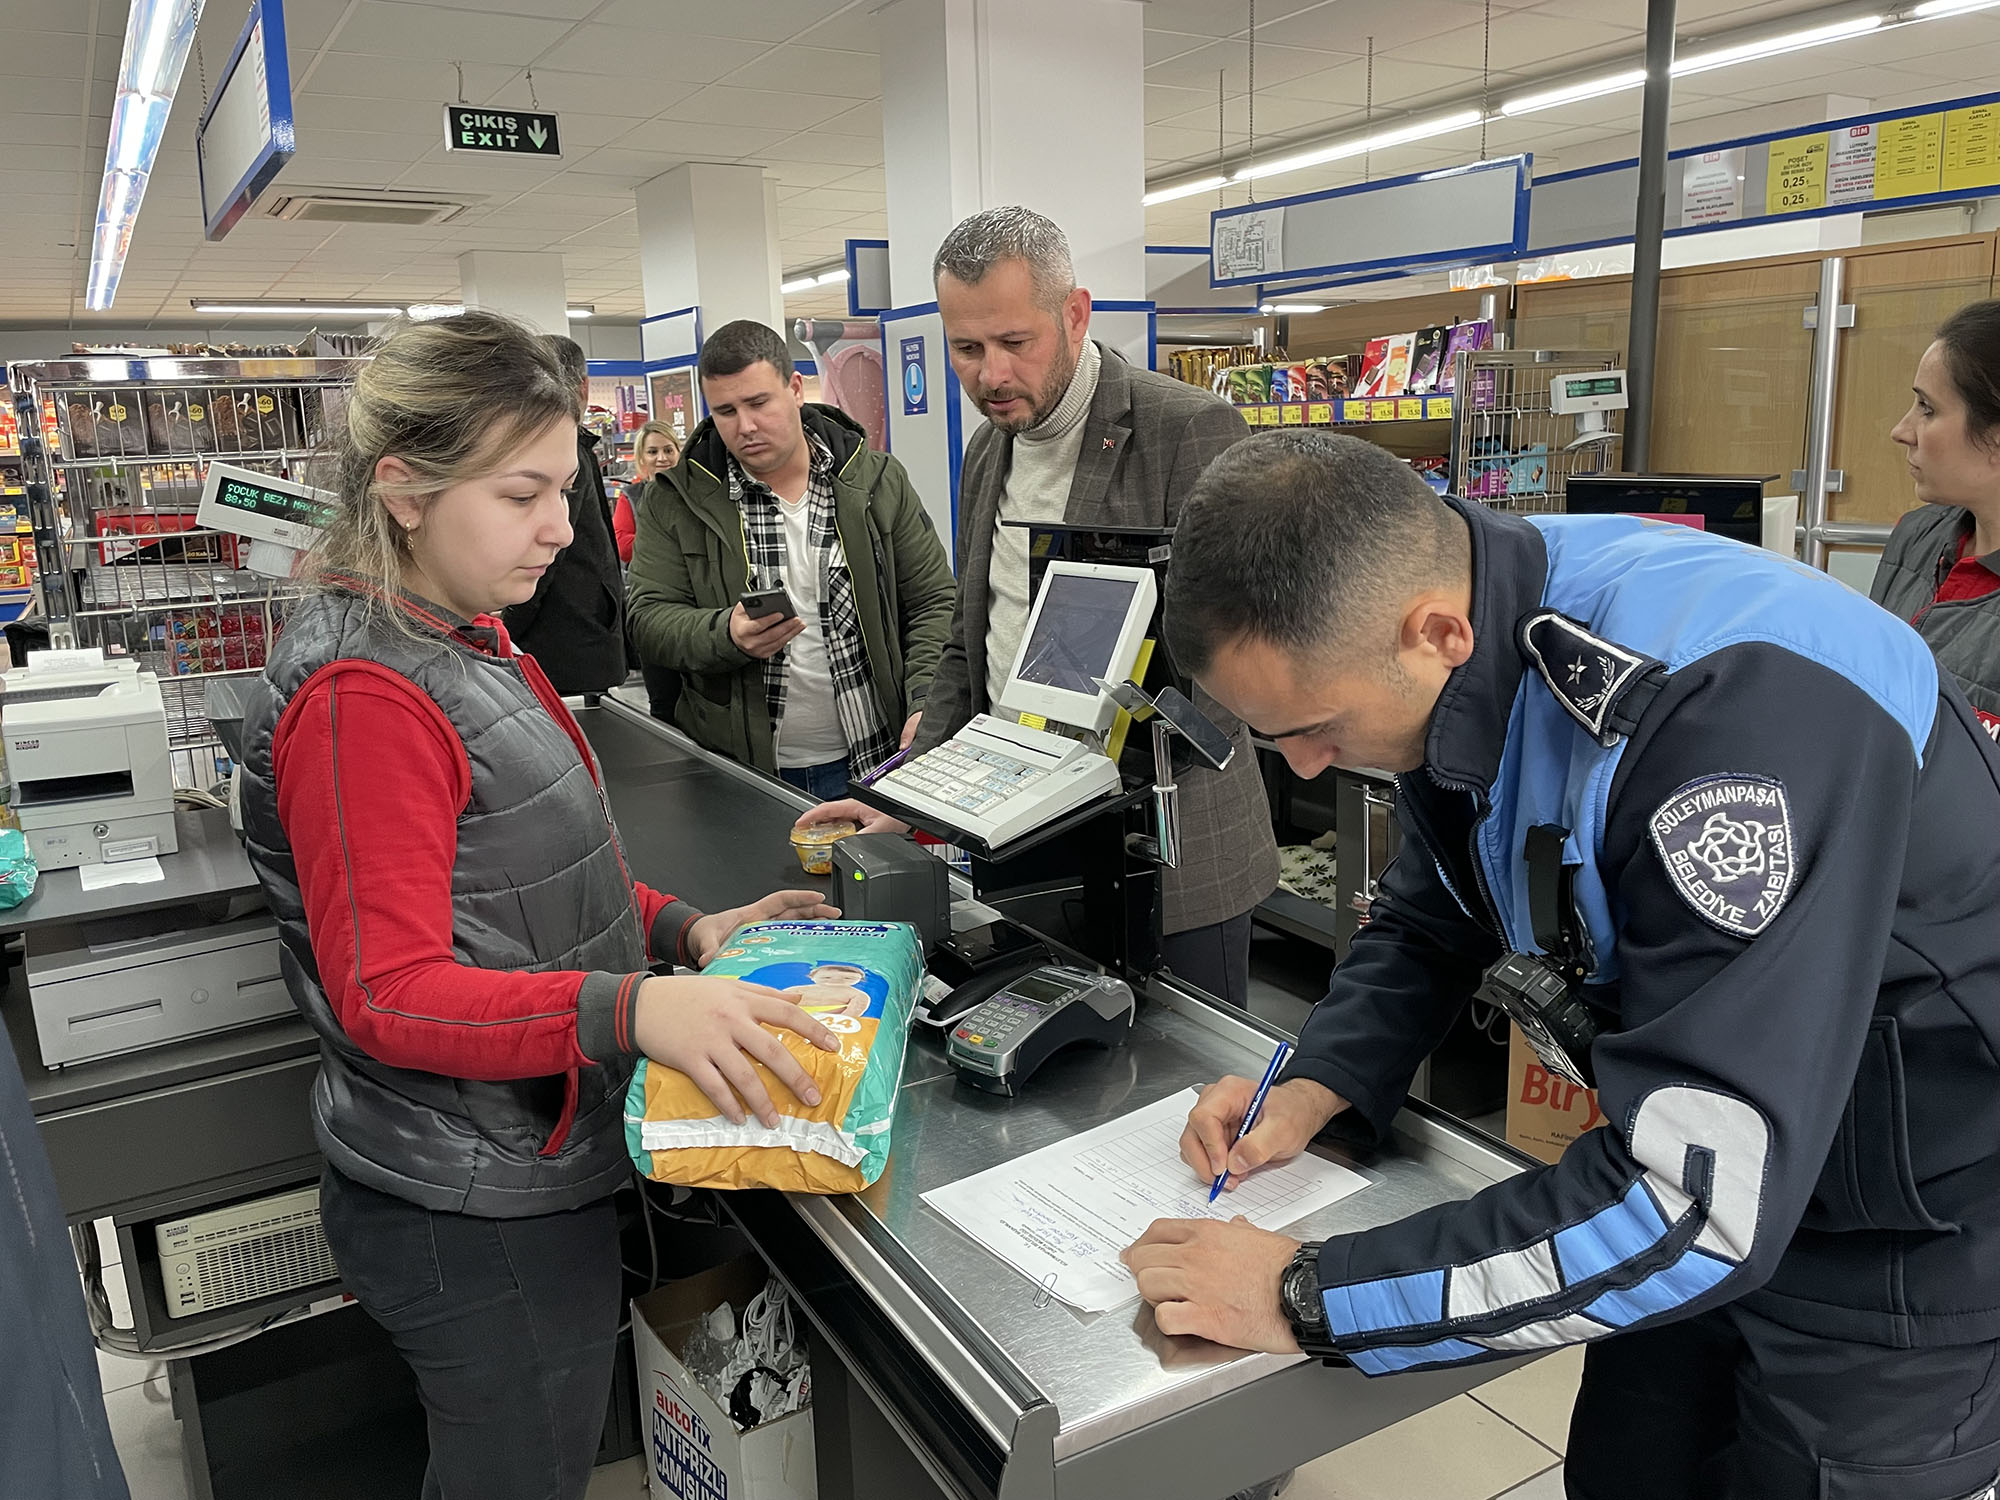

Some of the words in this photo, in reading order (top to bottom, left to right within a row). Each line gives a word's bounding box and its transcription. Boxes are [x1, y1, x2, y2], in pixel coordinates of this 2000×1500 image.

[460, 113, 518, 133] ÇIKIŞ
[461, 131, 519, 148] EXIT
[1783, 176, 1805, 189] 0,25
[1782, 194, 1804, 206] 0,25
[227, 483, 260, 499] ÇOCUK
[224, 493, 256, 509] 88,50
[1656, 785, 1777, 835] SÜLEYMANPAŞA
[1753, 824, 1787, 919] ZABITASI
[1670, 849, 1747, 924] BELEDİYE
[749, 924, 806, 933] Jenny
[656, 1389, 712, 1453] autofix
[655, 1442, 682, 1492] CAM
